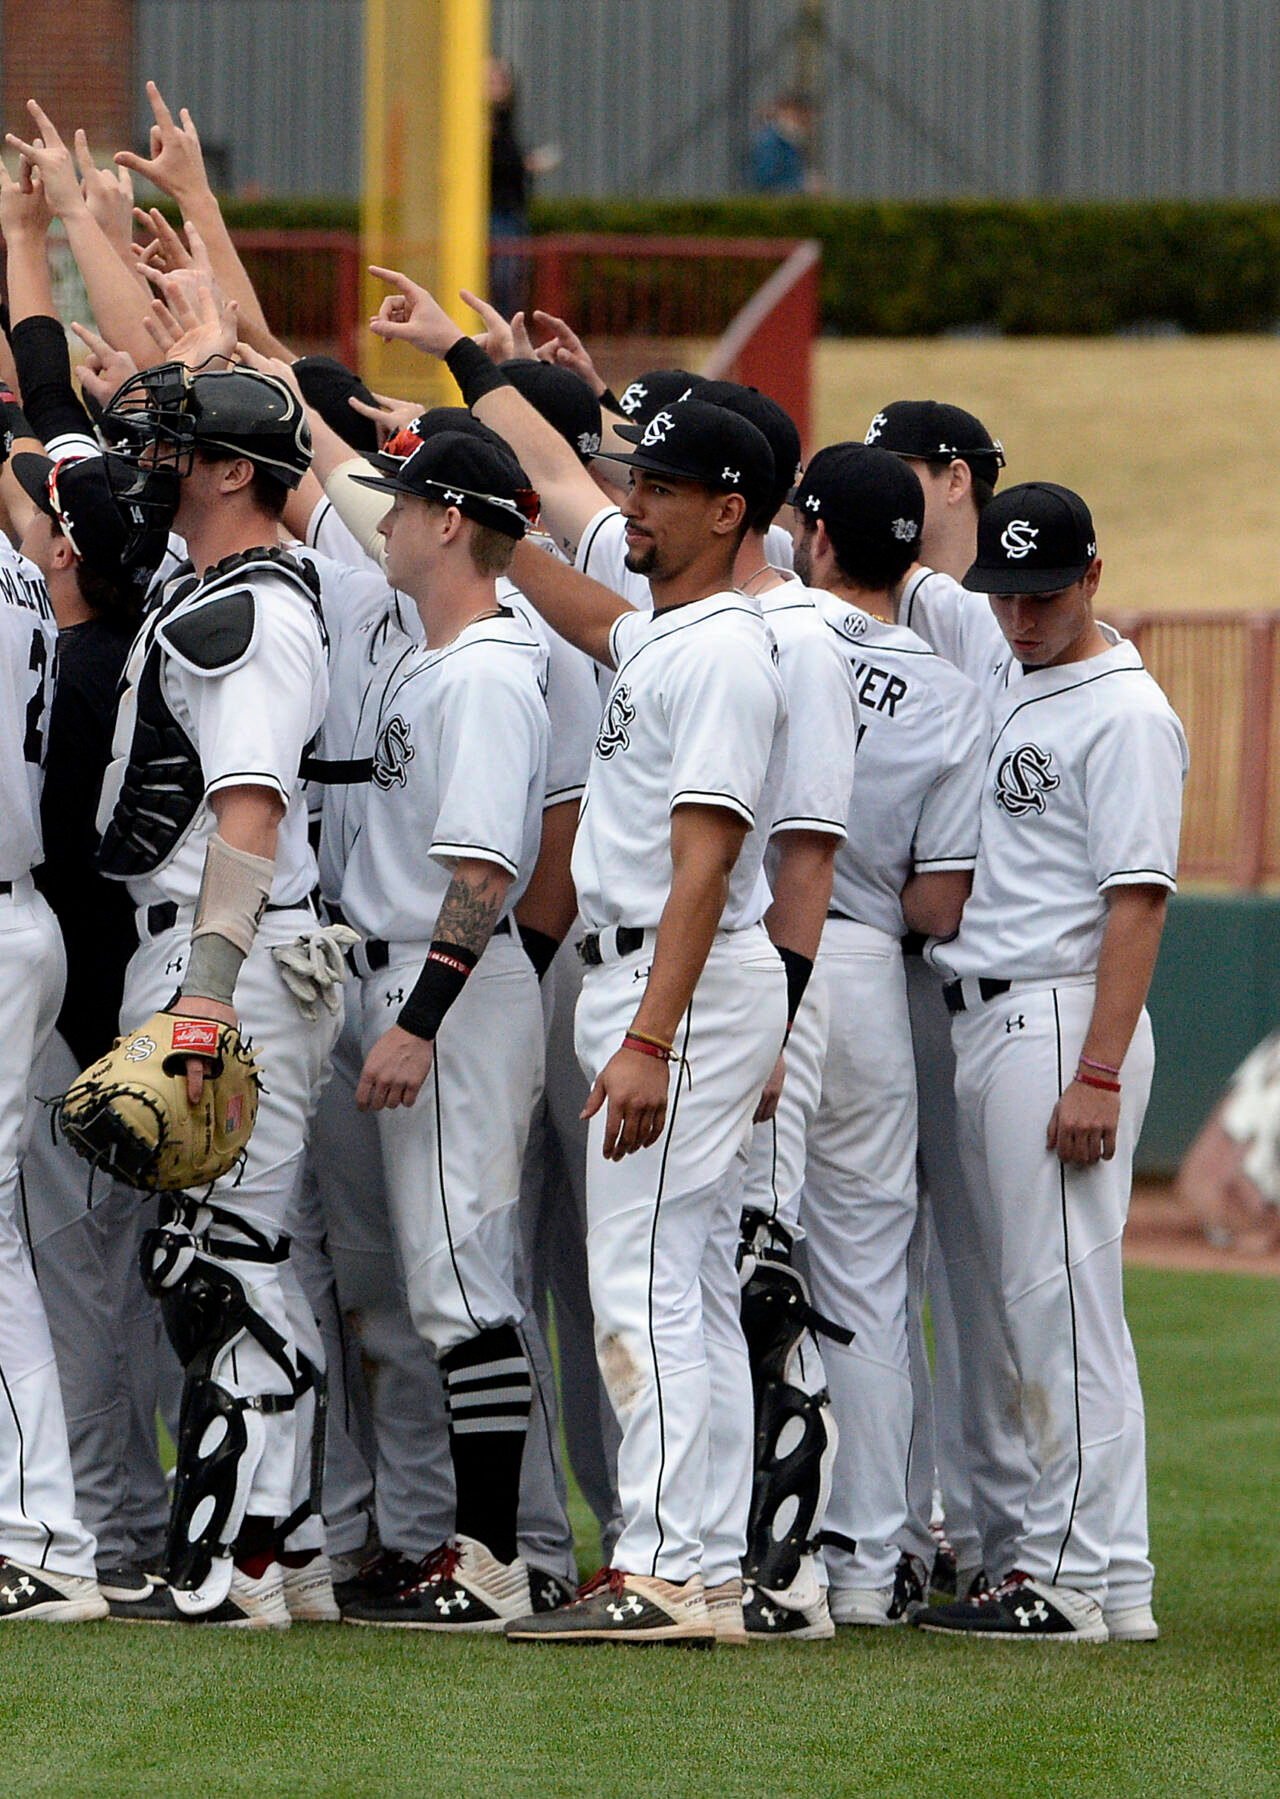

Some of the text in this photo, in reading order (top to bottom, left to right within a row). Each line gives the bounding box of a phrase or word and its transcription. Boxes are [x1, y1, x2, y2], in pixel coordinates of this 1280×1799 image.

[640, 411, 676, 446] SC
[129, 505, 145, 523] 14
[1001, 520, 1039, 558] SC
[844, 612, 868, 638] SEC
[994, 742, 1061, 818] SC
